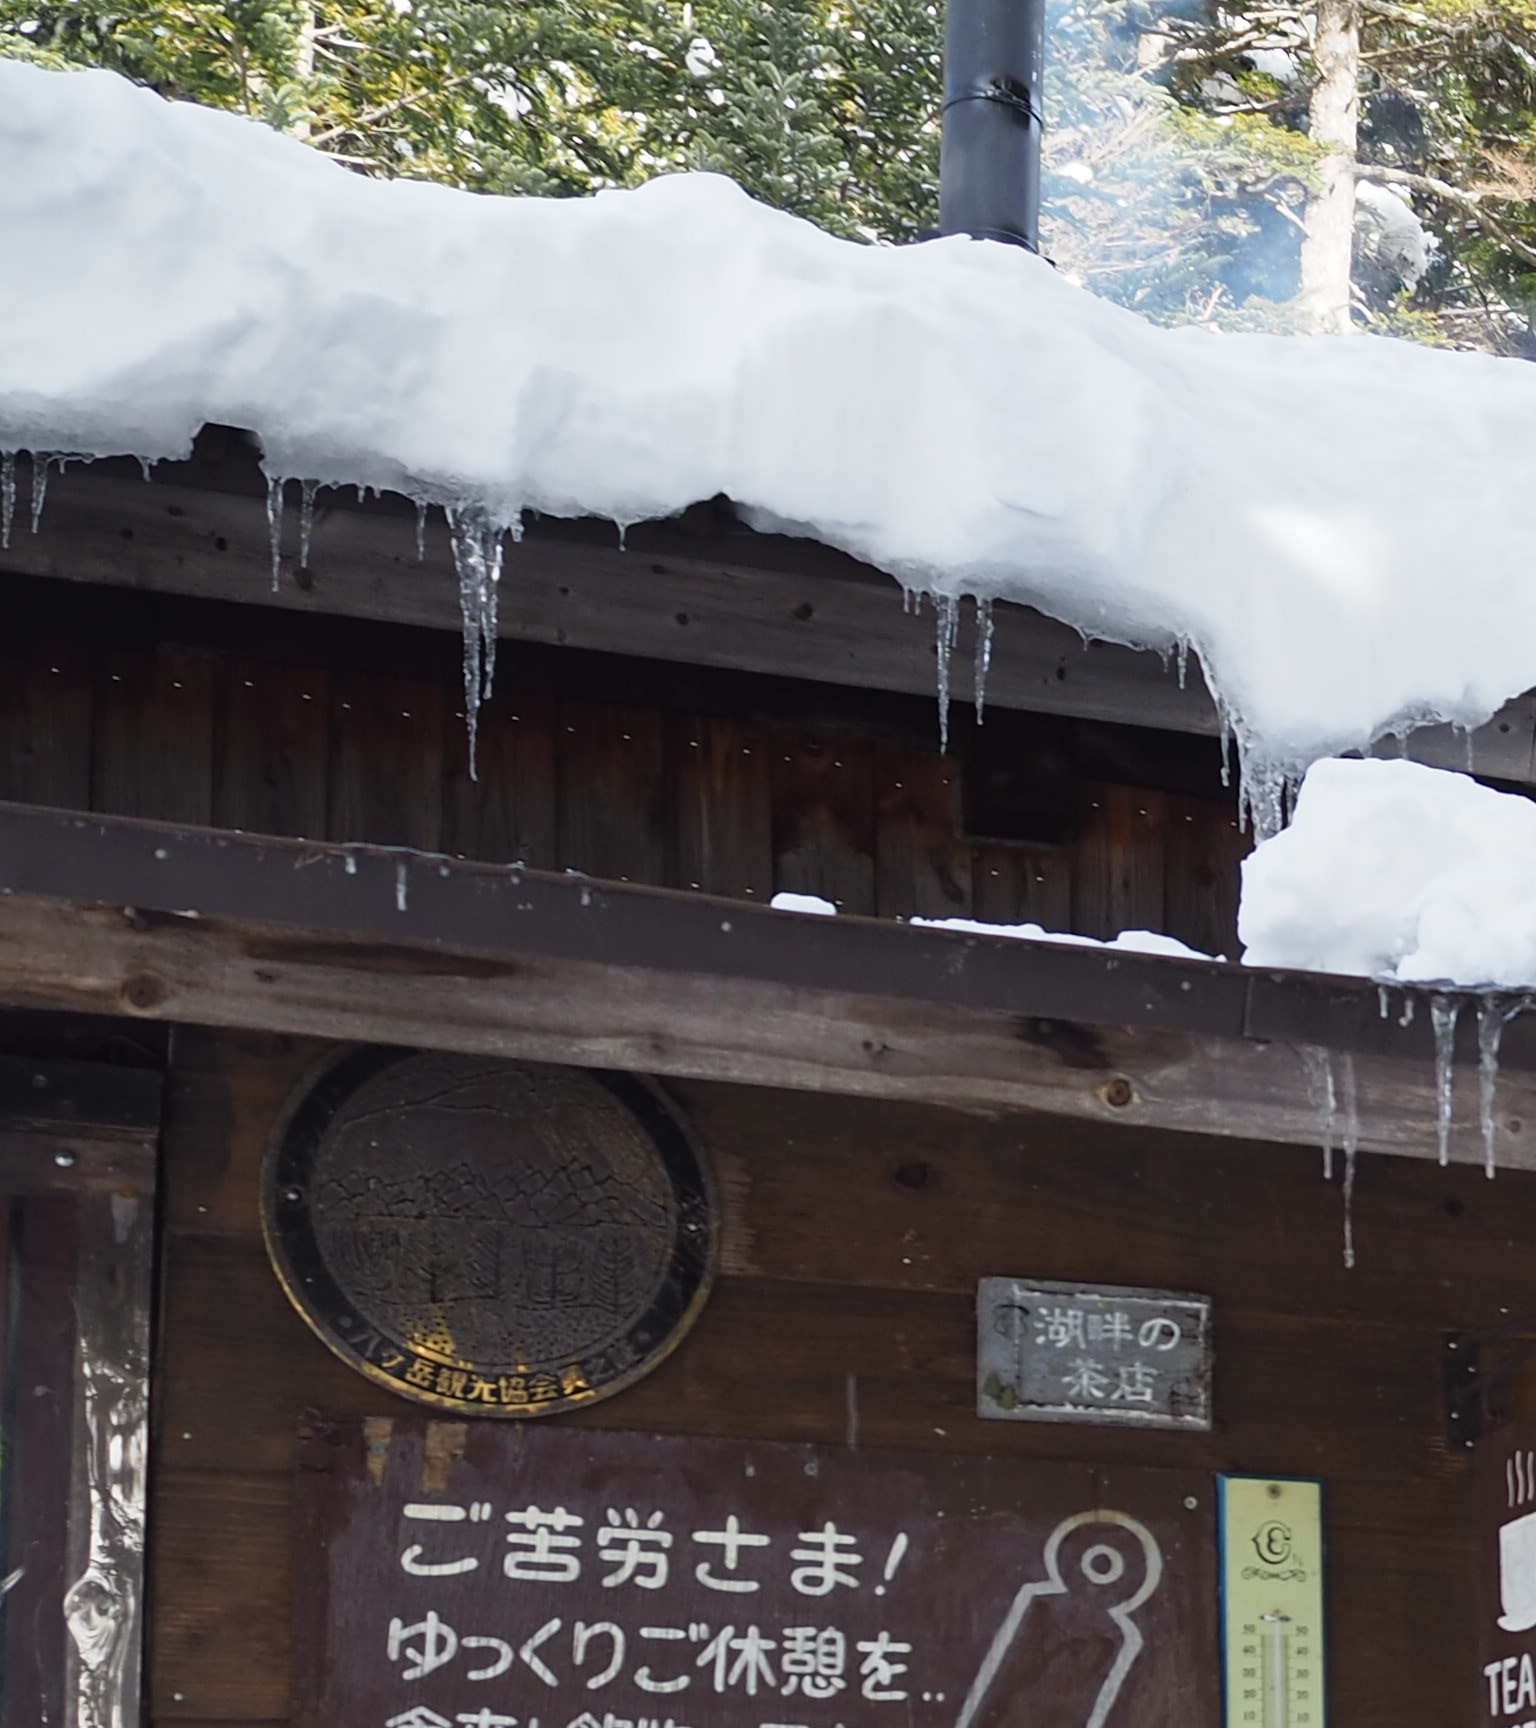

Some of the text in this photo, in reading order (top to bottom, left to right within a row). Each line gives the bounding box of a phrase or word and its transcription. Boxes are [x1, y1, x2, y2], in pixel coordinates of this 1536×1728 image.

[1033, 1307, 1181, 1351] 湖畔の
[1060, 1358, 1157, 1403] 茶店
